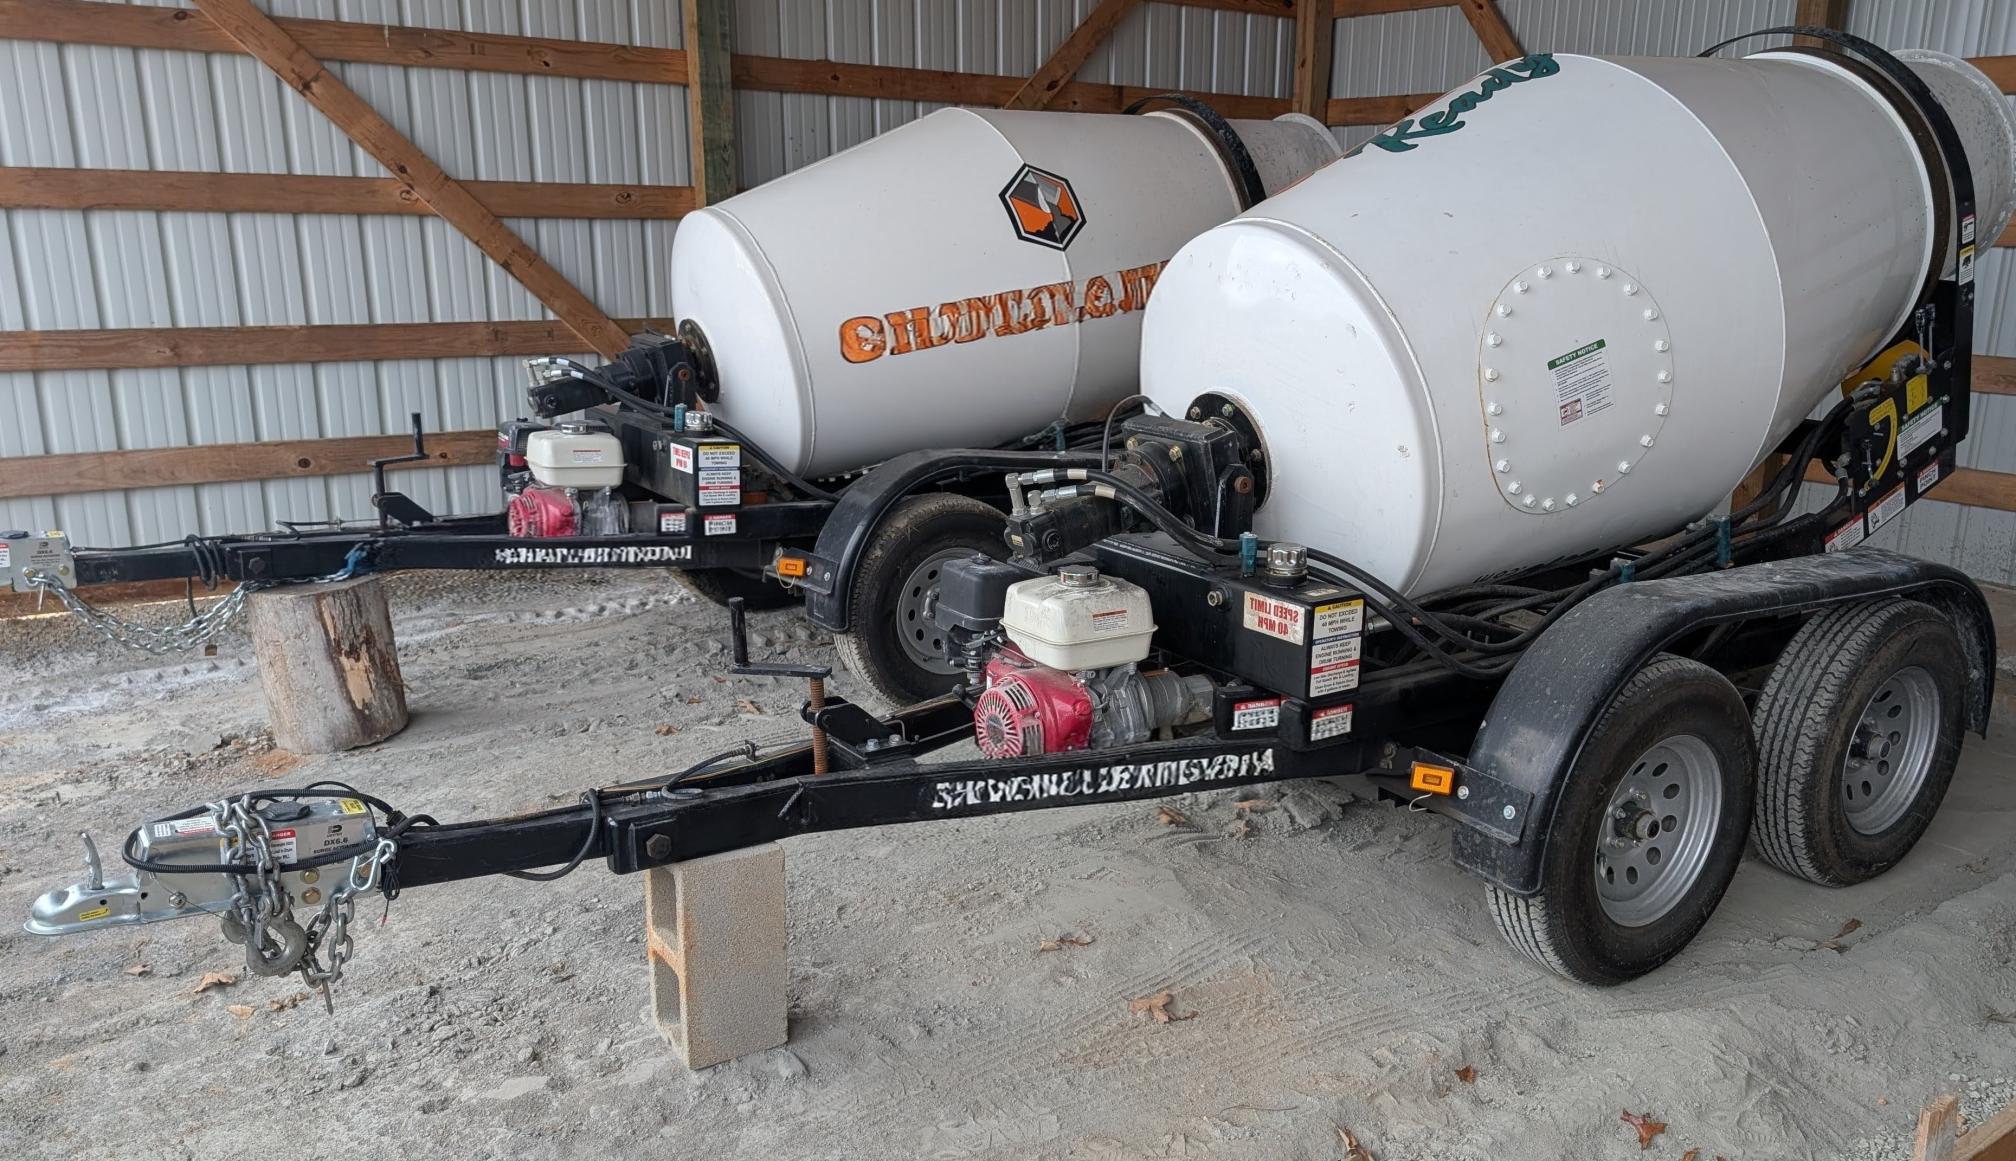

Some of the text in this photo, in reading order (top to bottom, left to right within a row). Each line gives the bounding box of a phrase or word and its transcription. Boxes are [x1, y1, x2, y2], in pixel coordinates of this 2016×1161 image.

[1556, 344, 1598, 366] SAFETY NOTICE
[1339, 608, 1358, 616] EXCEED
